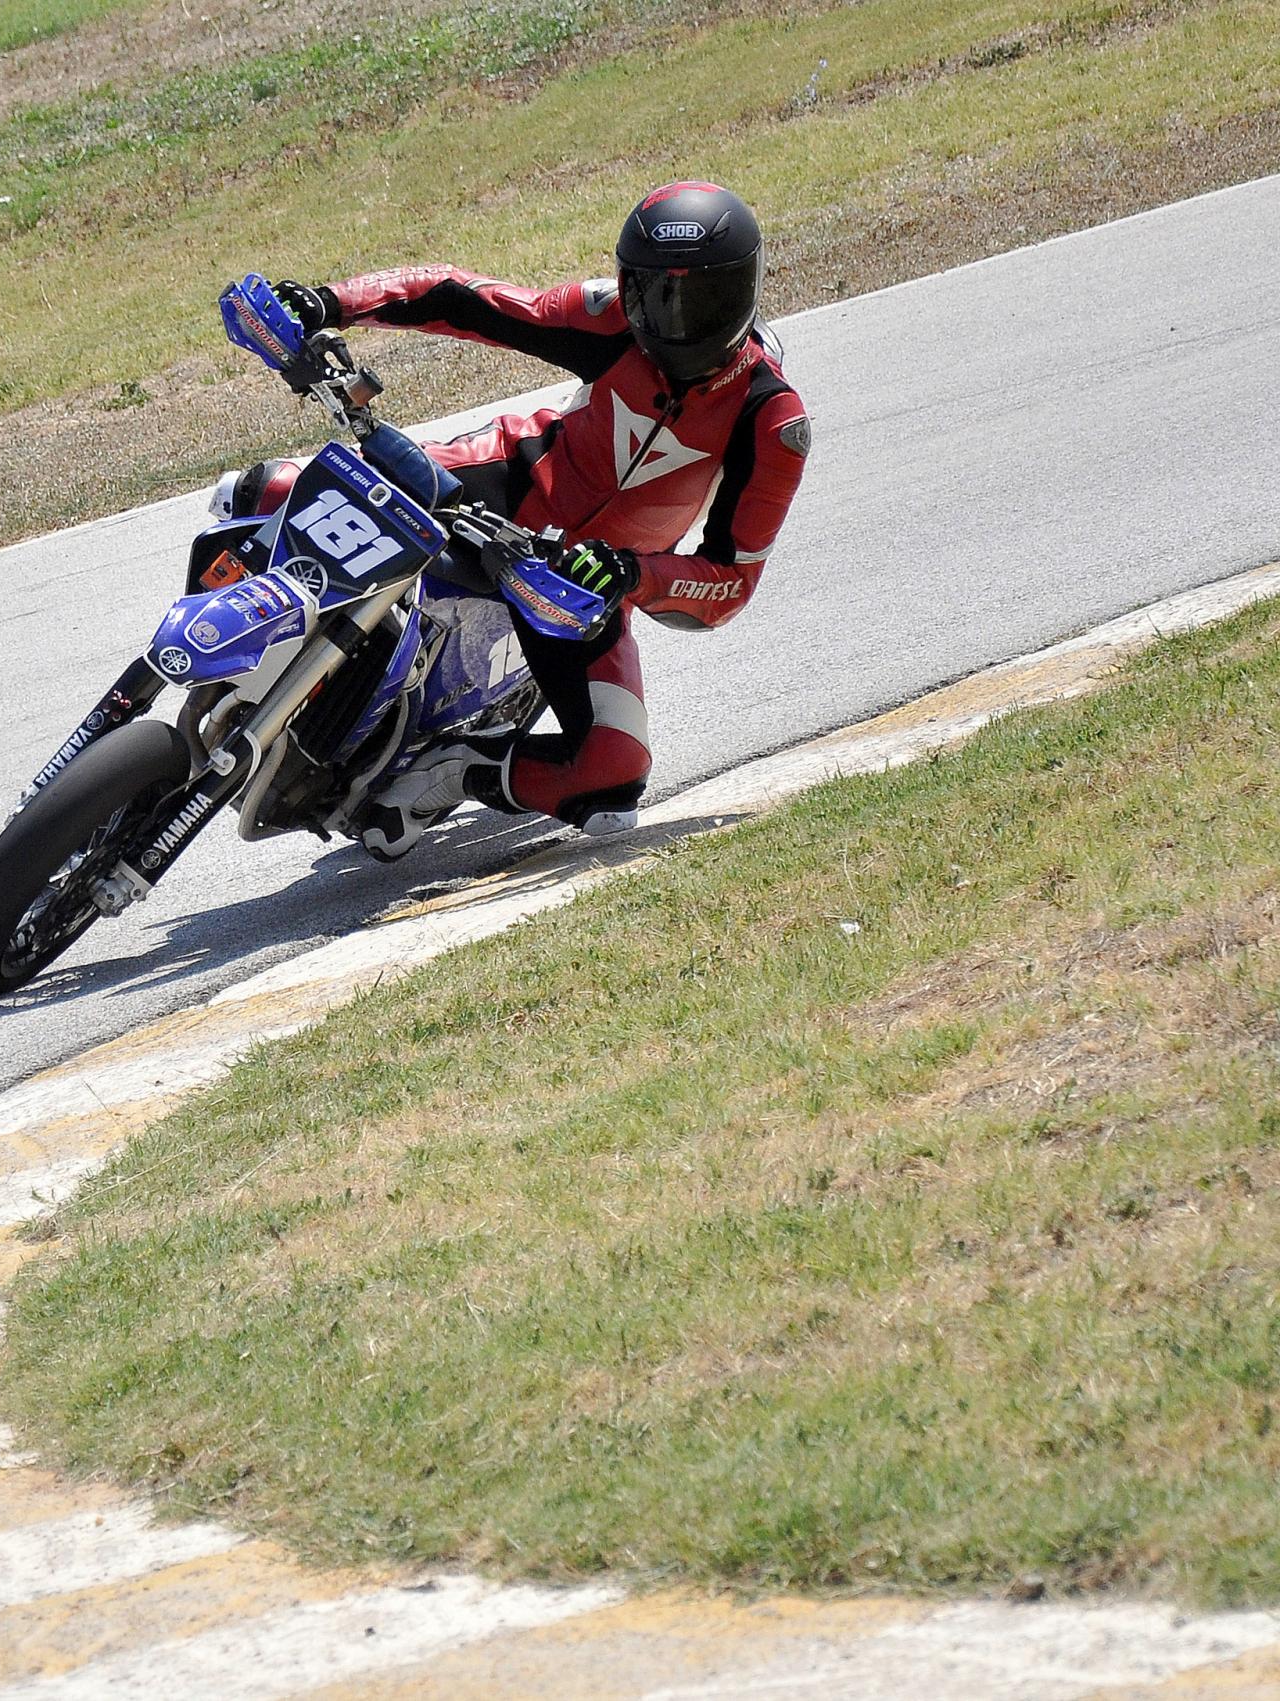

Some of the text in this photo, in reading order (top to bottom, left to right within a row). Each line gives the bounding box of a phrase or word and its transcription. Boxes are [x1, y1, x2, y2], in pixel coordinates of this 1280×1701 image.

[658, 224, 698, 238] SHOEI
[288, 489, 404, 579] 181
[35, 727, 92, 787] YAMAHA
[153, 792, 213, 854] YAMAHA
